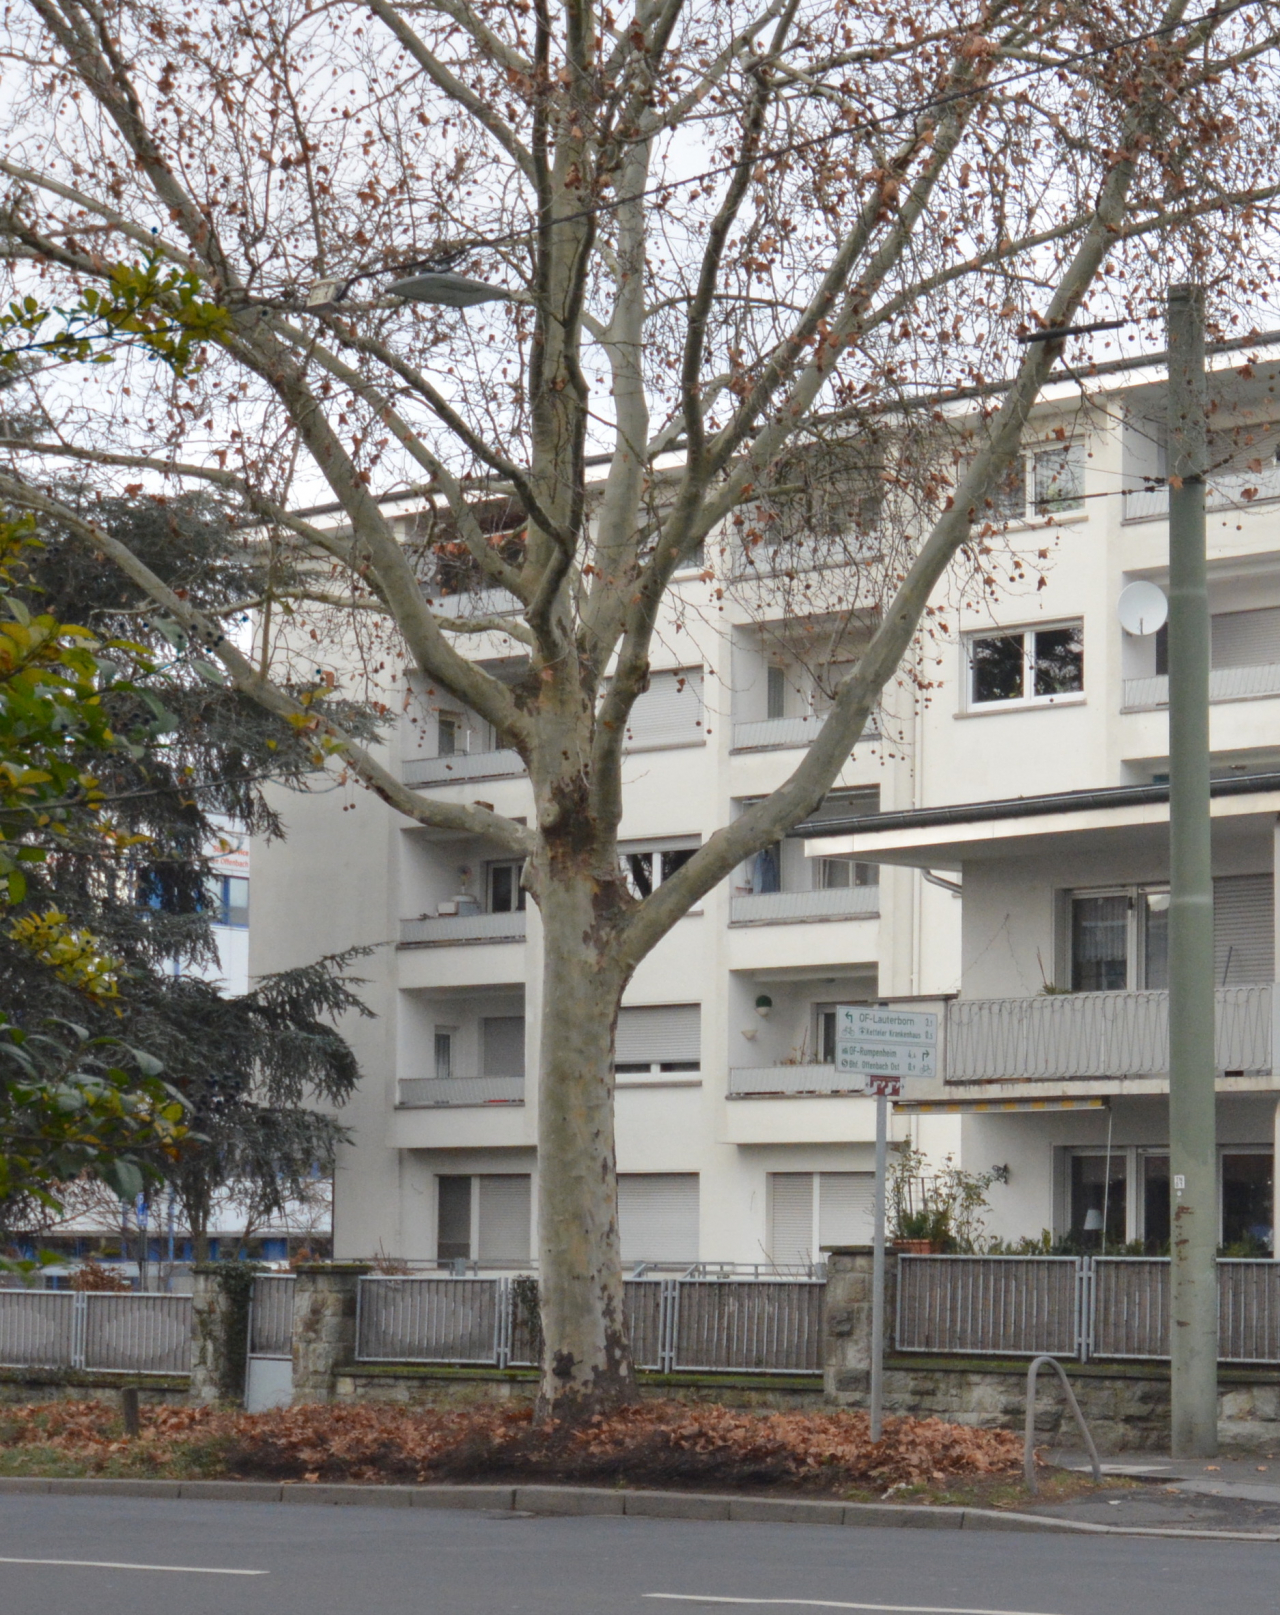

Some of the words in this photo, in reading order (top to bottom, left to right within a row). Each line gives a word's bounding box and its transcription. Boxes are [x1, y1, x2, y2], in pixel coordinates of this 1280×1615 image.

[859, 1013, 915, 1026] OF-Lauterborn
[889, 1030, 921, 1039] Krankenhaus
[849, 1046, 897, 1058] OF-Rumpenheim
[862, 1061, 888, 1071] Offenbach
[891, 1062, 900, 1071] Ost
